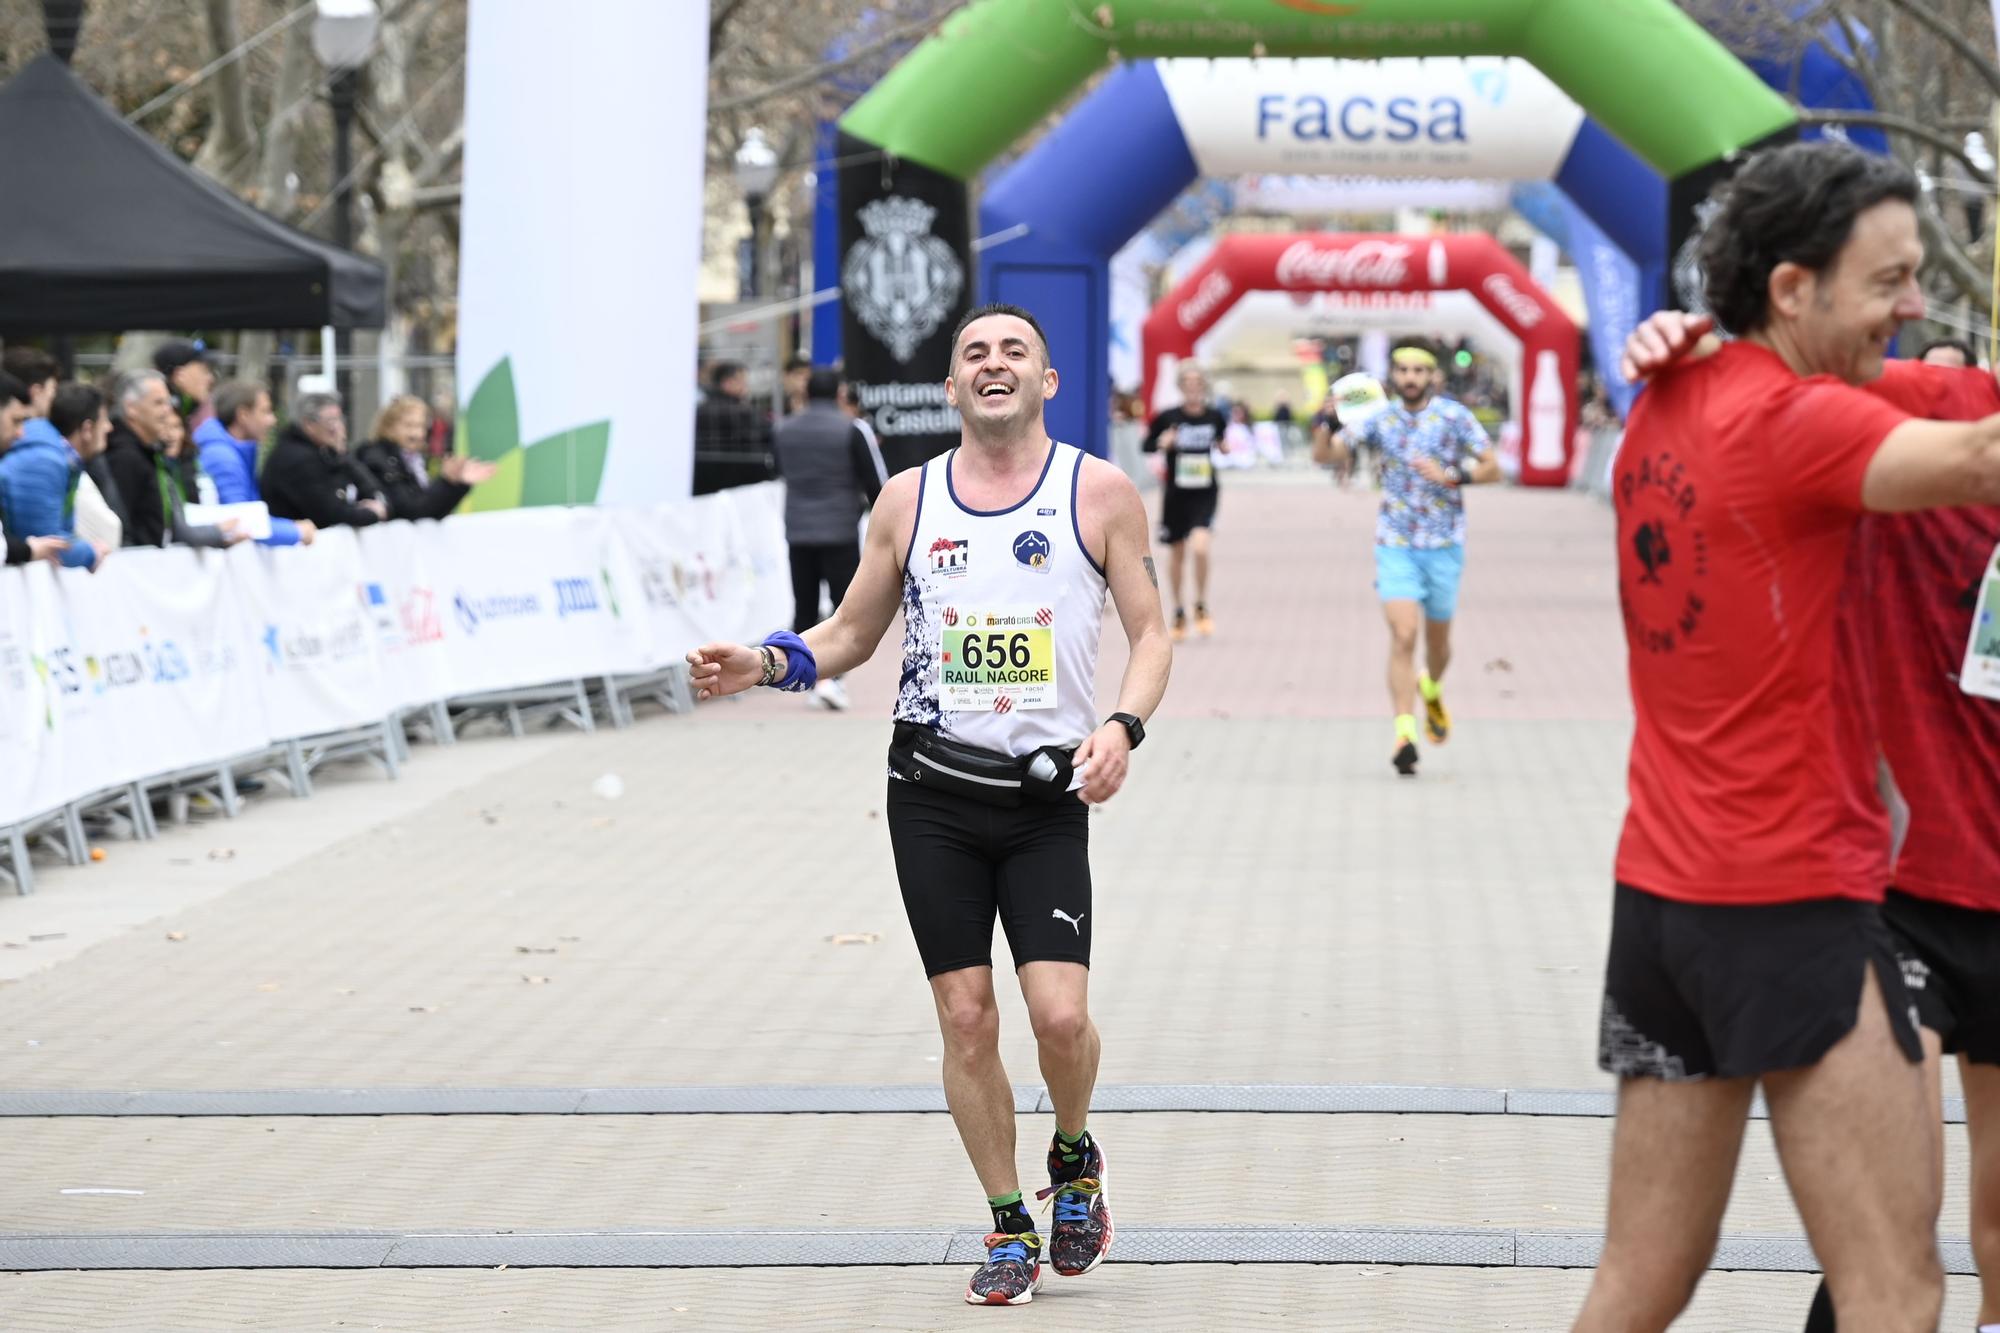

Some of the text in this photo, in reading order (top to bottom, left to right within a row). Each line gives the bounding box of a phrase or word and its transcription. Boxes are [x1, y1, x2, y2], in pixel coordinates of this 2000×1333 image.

[962, 633, 1031, 669] 656
[945, 669, 1049, 684] RAUL NAGORE
